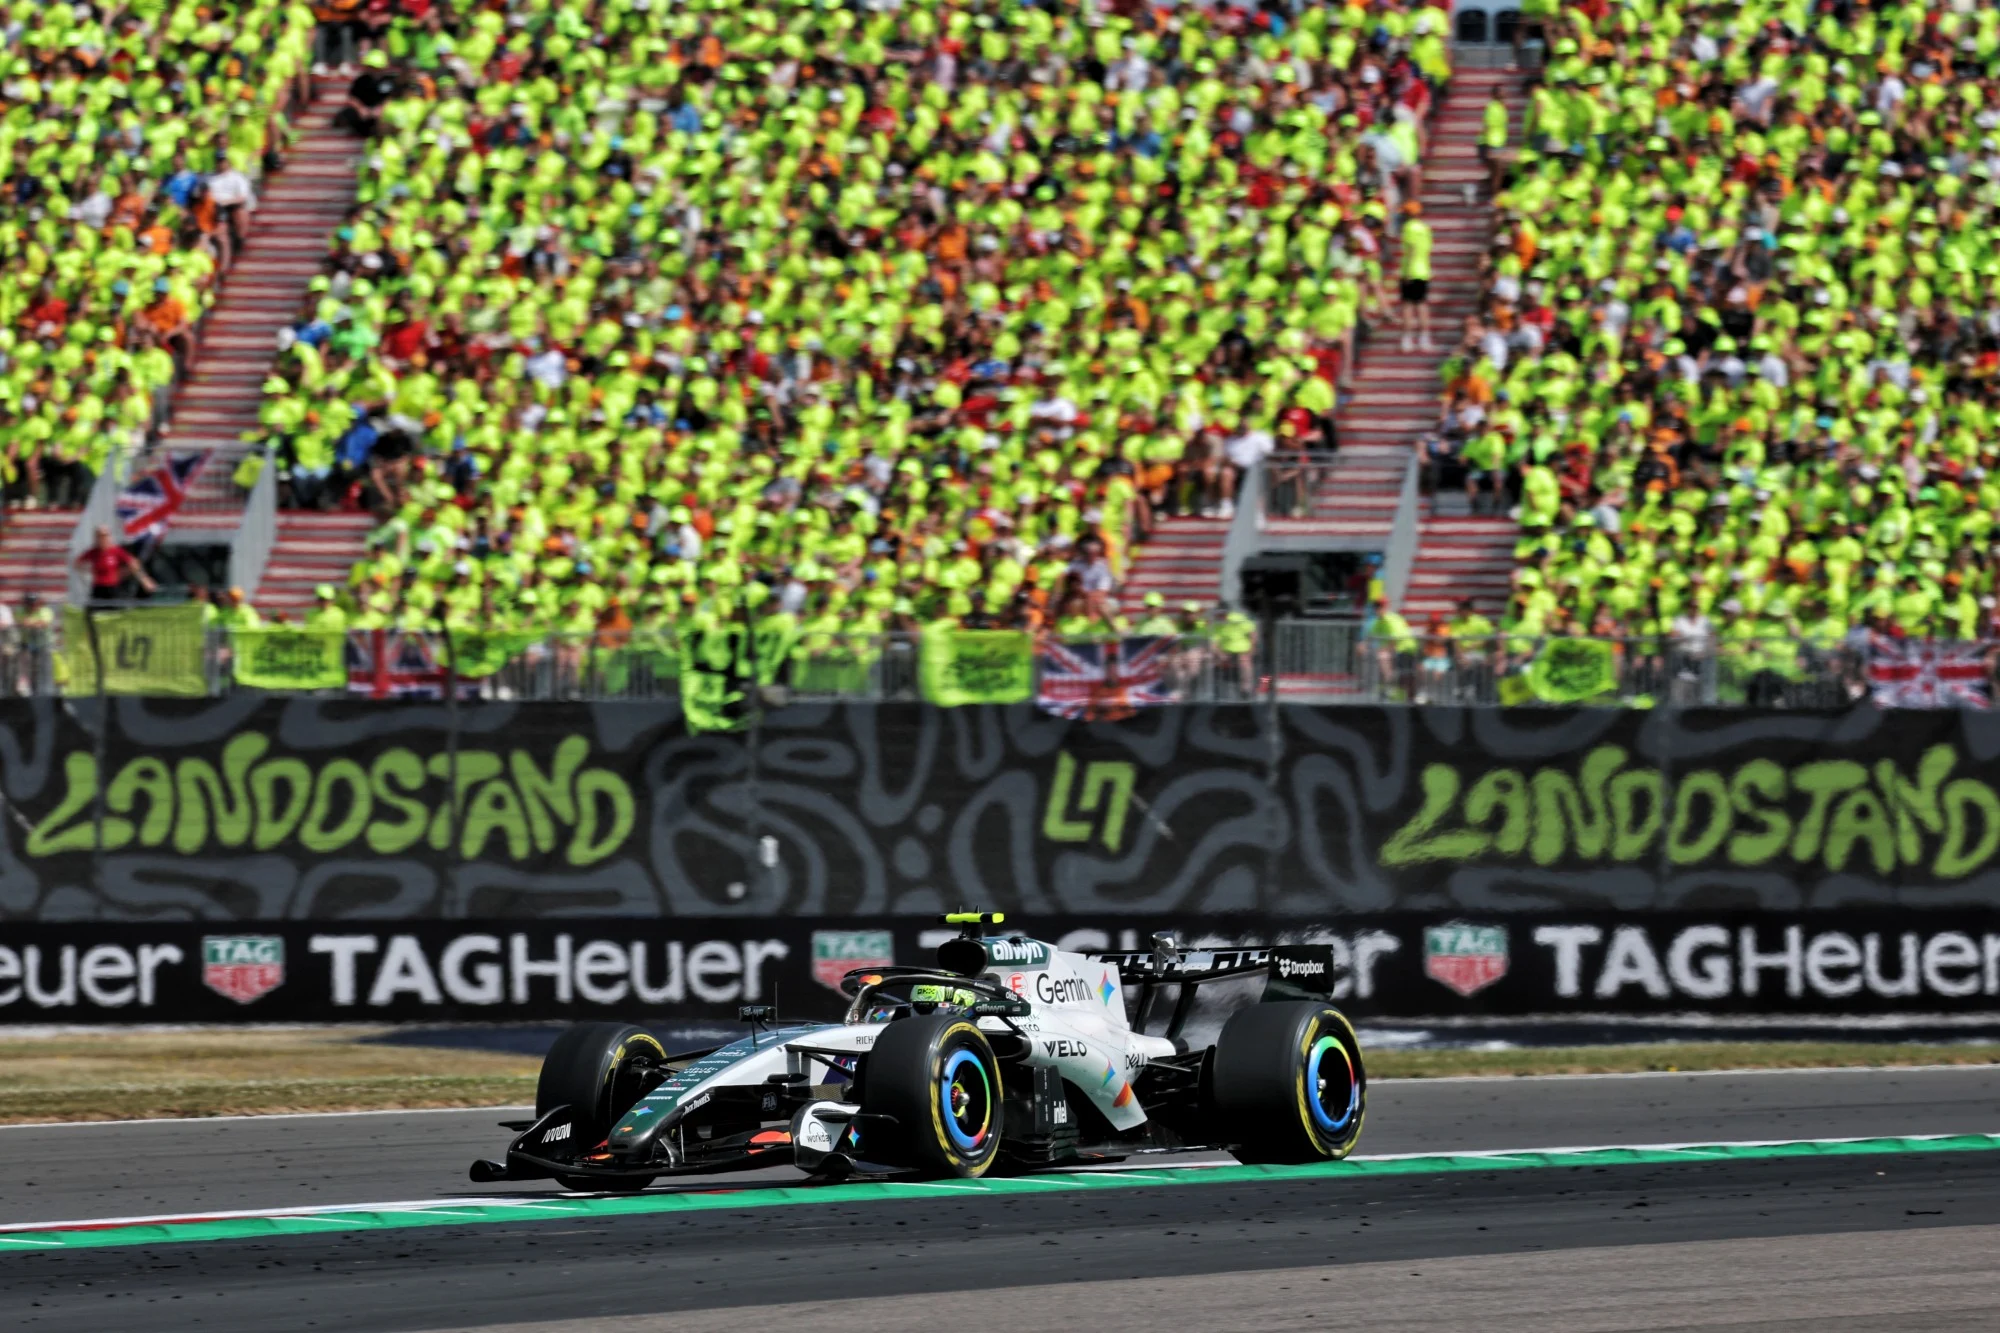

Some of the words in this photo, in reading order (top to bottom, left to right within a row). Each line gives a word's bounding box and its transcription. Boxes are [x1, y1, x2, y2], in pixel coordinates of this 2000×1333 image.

[26, 731, 635, 866] LANDOSTAND
[1378, 744, 2000, 879] LANDOSTAND
[206, 940, 277, 963] TAG
[992, 940, 1043, 964] allwyn
[1291, 961, 1325, 977] Dropbox
[1037, 971, 1093, 1004] Gemini
[976, 1003, 1006, 1013] allwyn
[856, 1035, 878, 1045] RICH
[1042, 1040, 1087, 1058] VELO
[1125, 1053, 1145, 1070] DELL
[807, 1132, 832, 1144] workday
